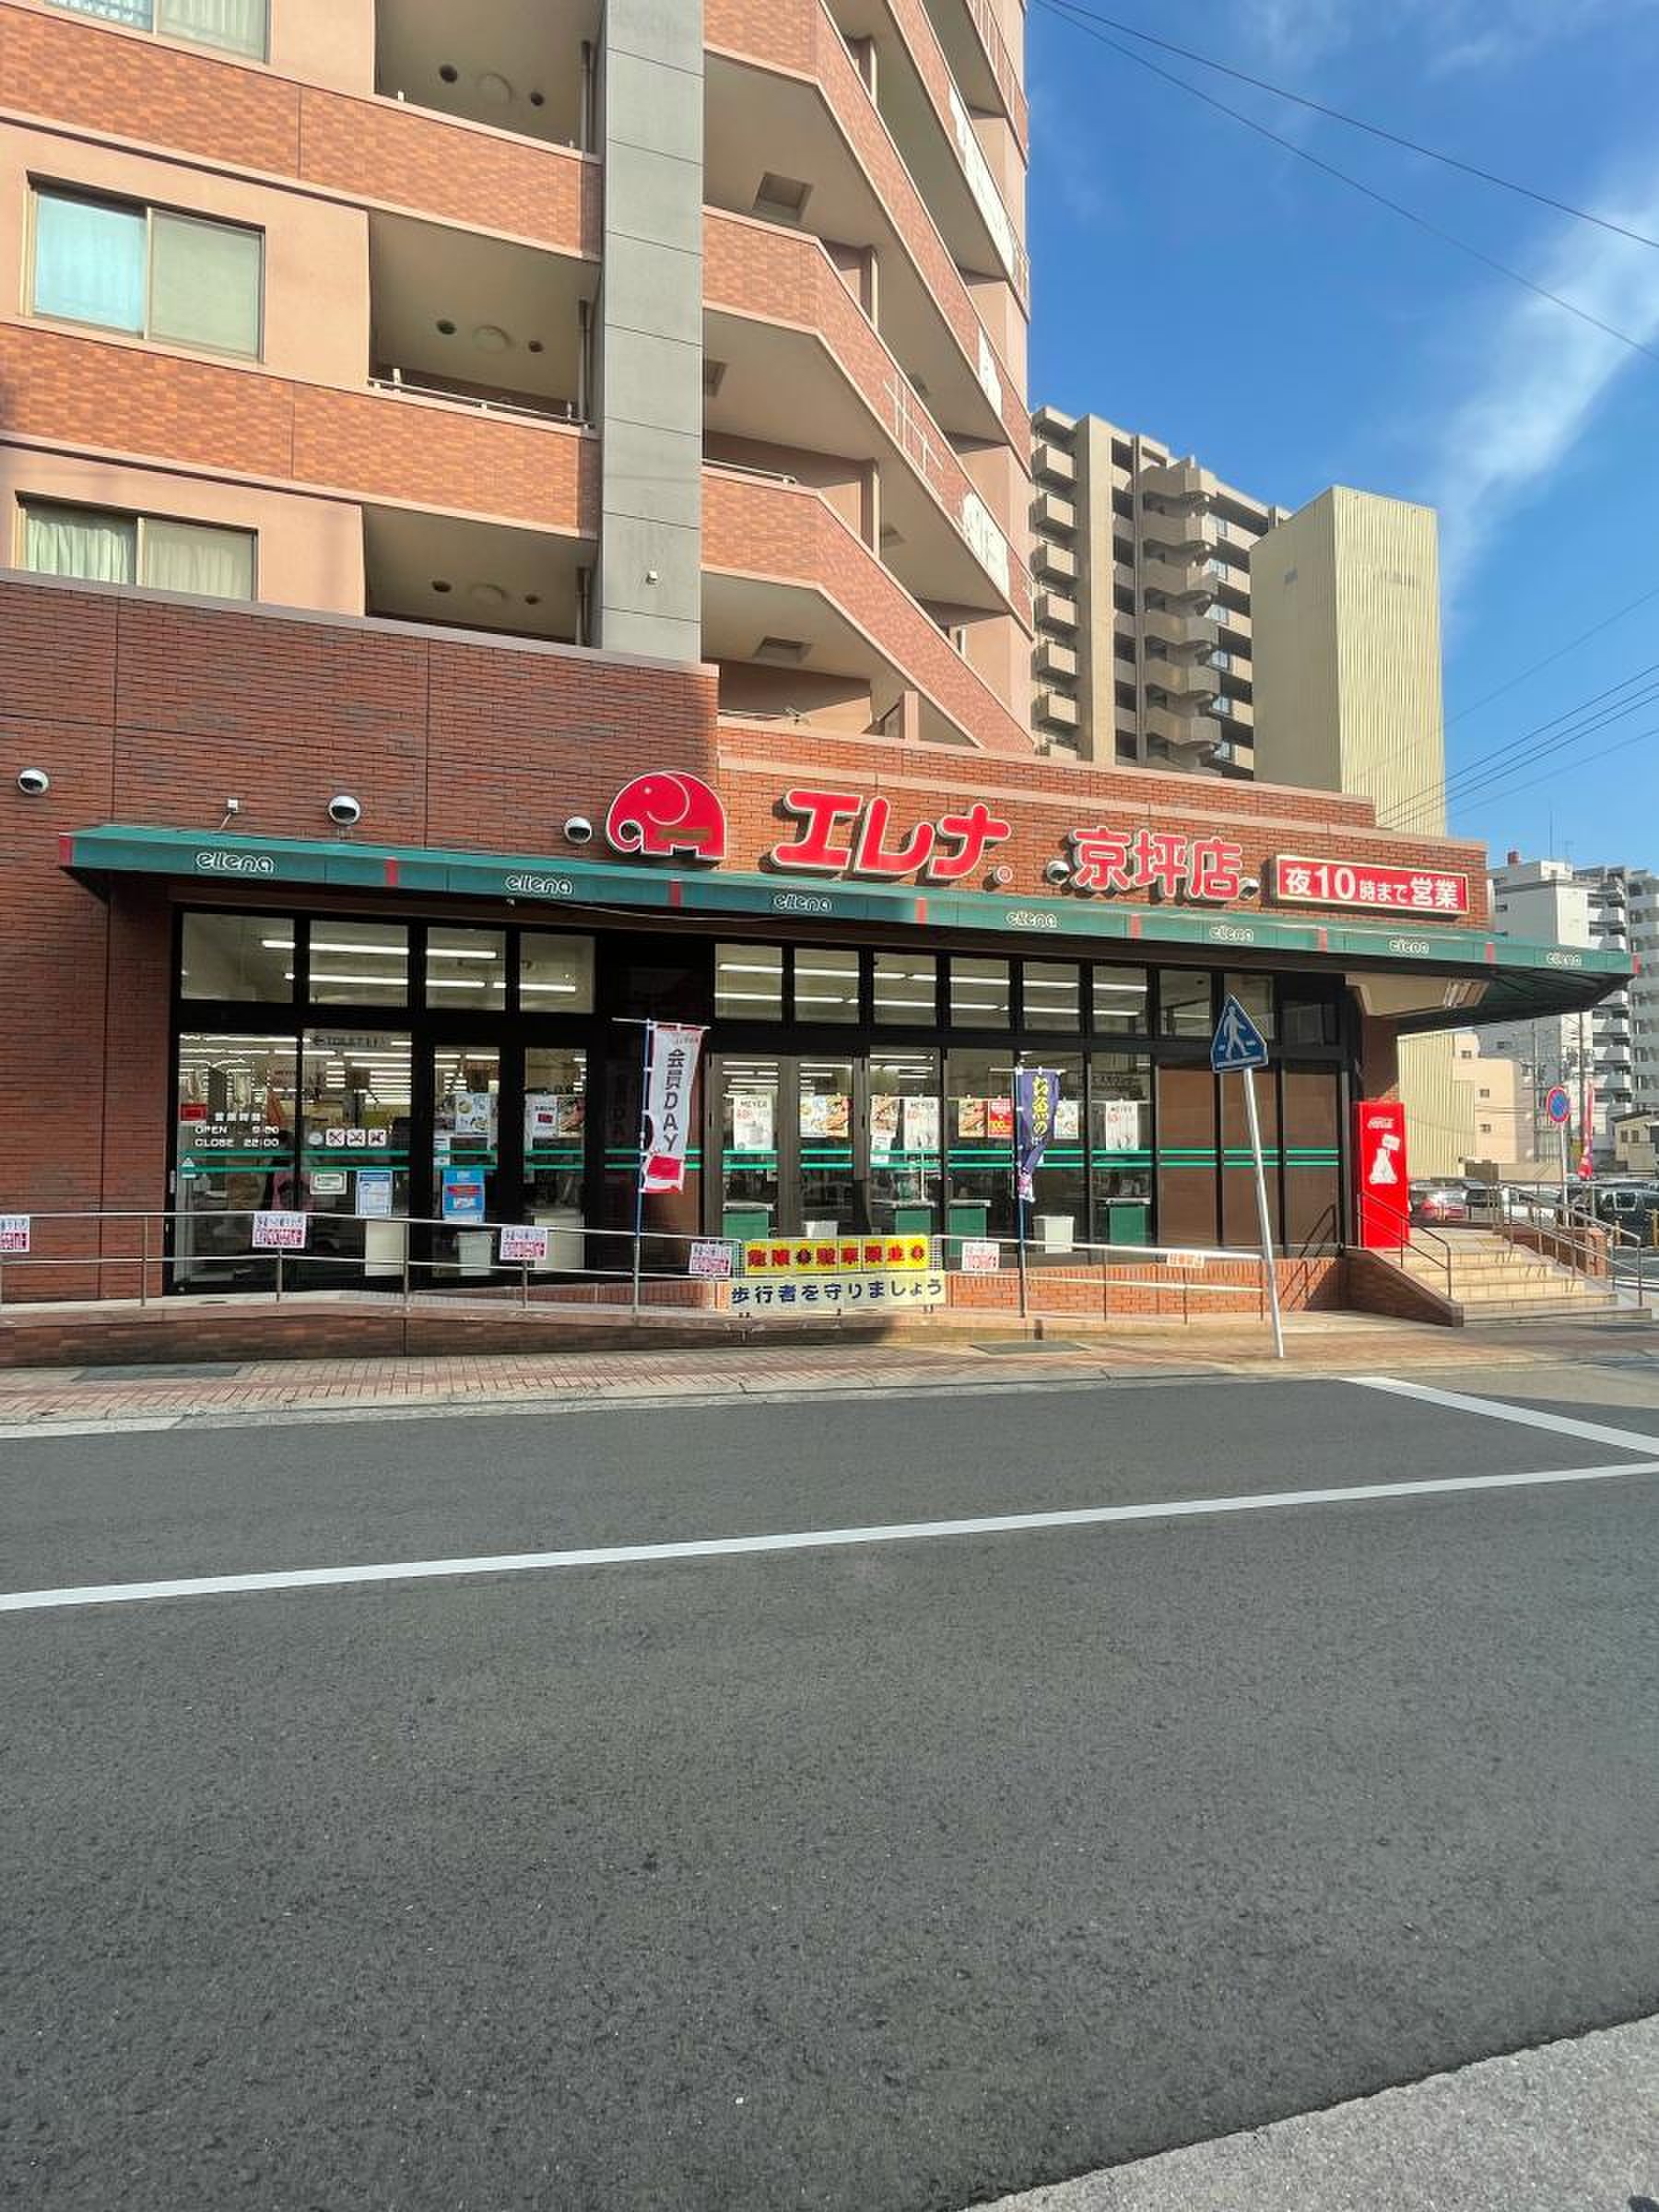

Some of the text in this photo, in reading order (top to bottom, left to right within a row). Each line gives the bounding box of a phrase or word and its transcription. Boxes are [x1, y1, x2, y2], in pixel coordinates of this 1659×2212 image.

[771, 788, 1012, 878] エレナ
[195, 852, 275, 874] ellena
[1071, 826, 1242, 900] 京坪店
[504, 875, 573, 896] ellena
[1286, 865, 1459, 909] 夜10時まで営業
[773, 894, 832, 912] ellena
[194, 1138, 234, 1147] CLOSE
[732, 1278, 942, 1304] 歩行者を守りましょう
